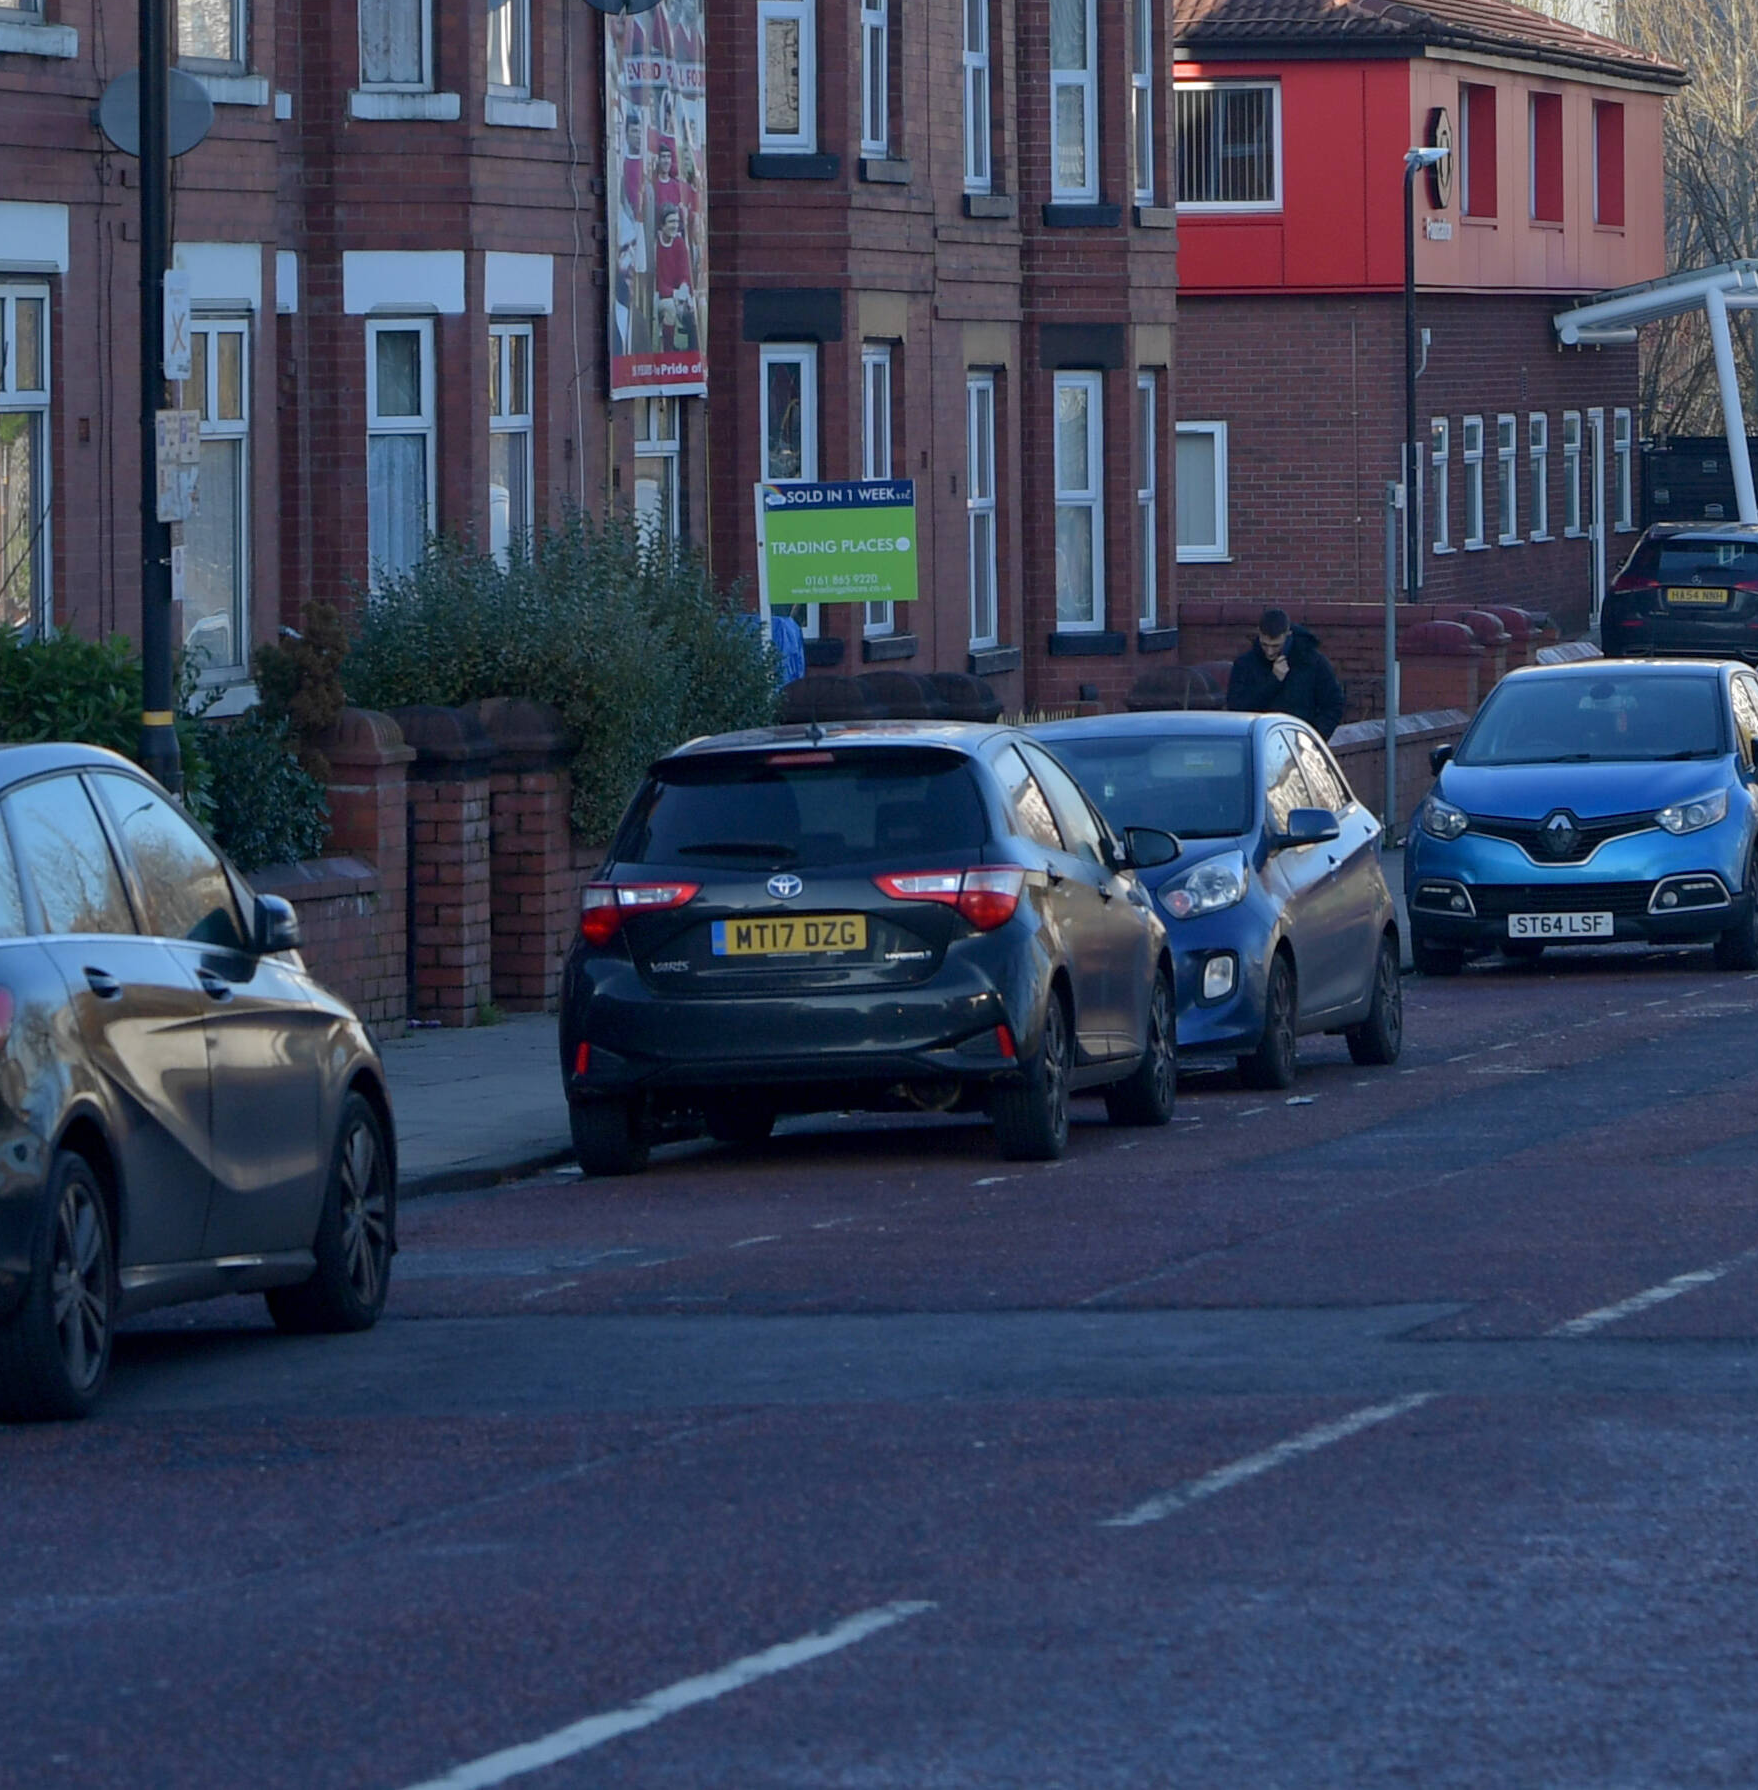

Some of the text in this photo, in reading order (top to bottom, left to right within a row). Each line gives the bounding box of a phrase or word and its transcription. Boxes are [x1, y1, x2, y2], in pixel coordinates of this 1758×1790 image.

[660, 362, 689, 375] Pride
[786, 490, 823, 504] SOLD
[826, 489, 842, 502] IN
[847, 489, 853, 501] 1
[858, 488, 895, 500] WEEK
[771, 538, 894, 555] TRADING PLACES
[805, 574, 878, 586] 0161 865 9220
[1517, 915, 1604, 933] ST64 LSF
[735, 921, 856, 949] MT17 DZG
